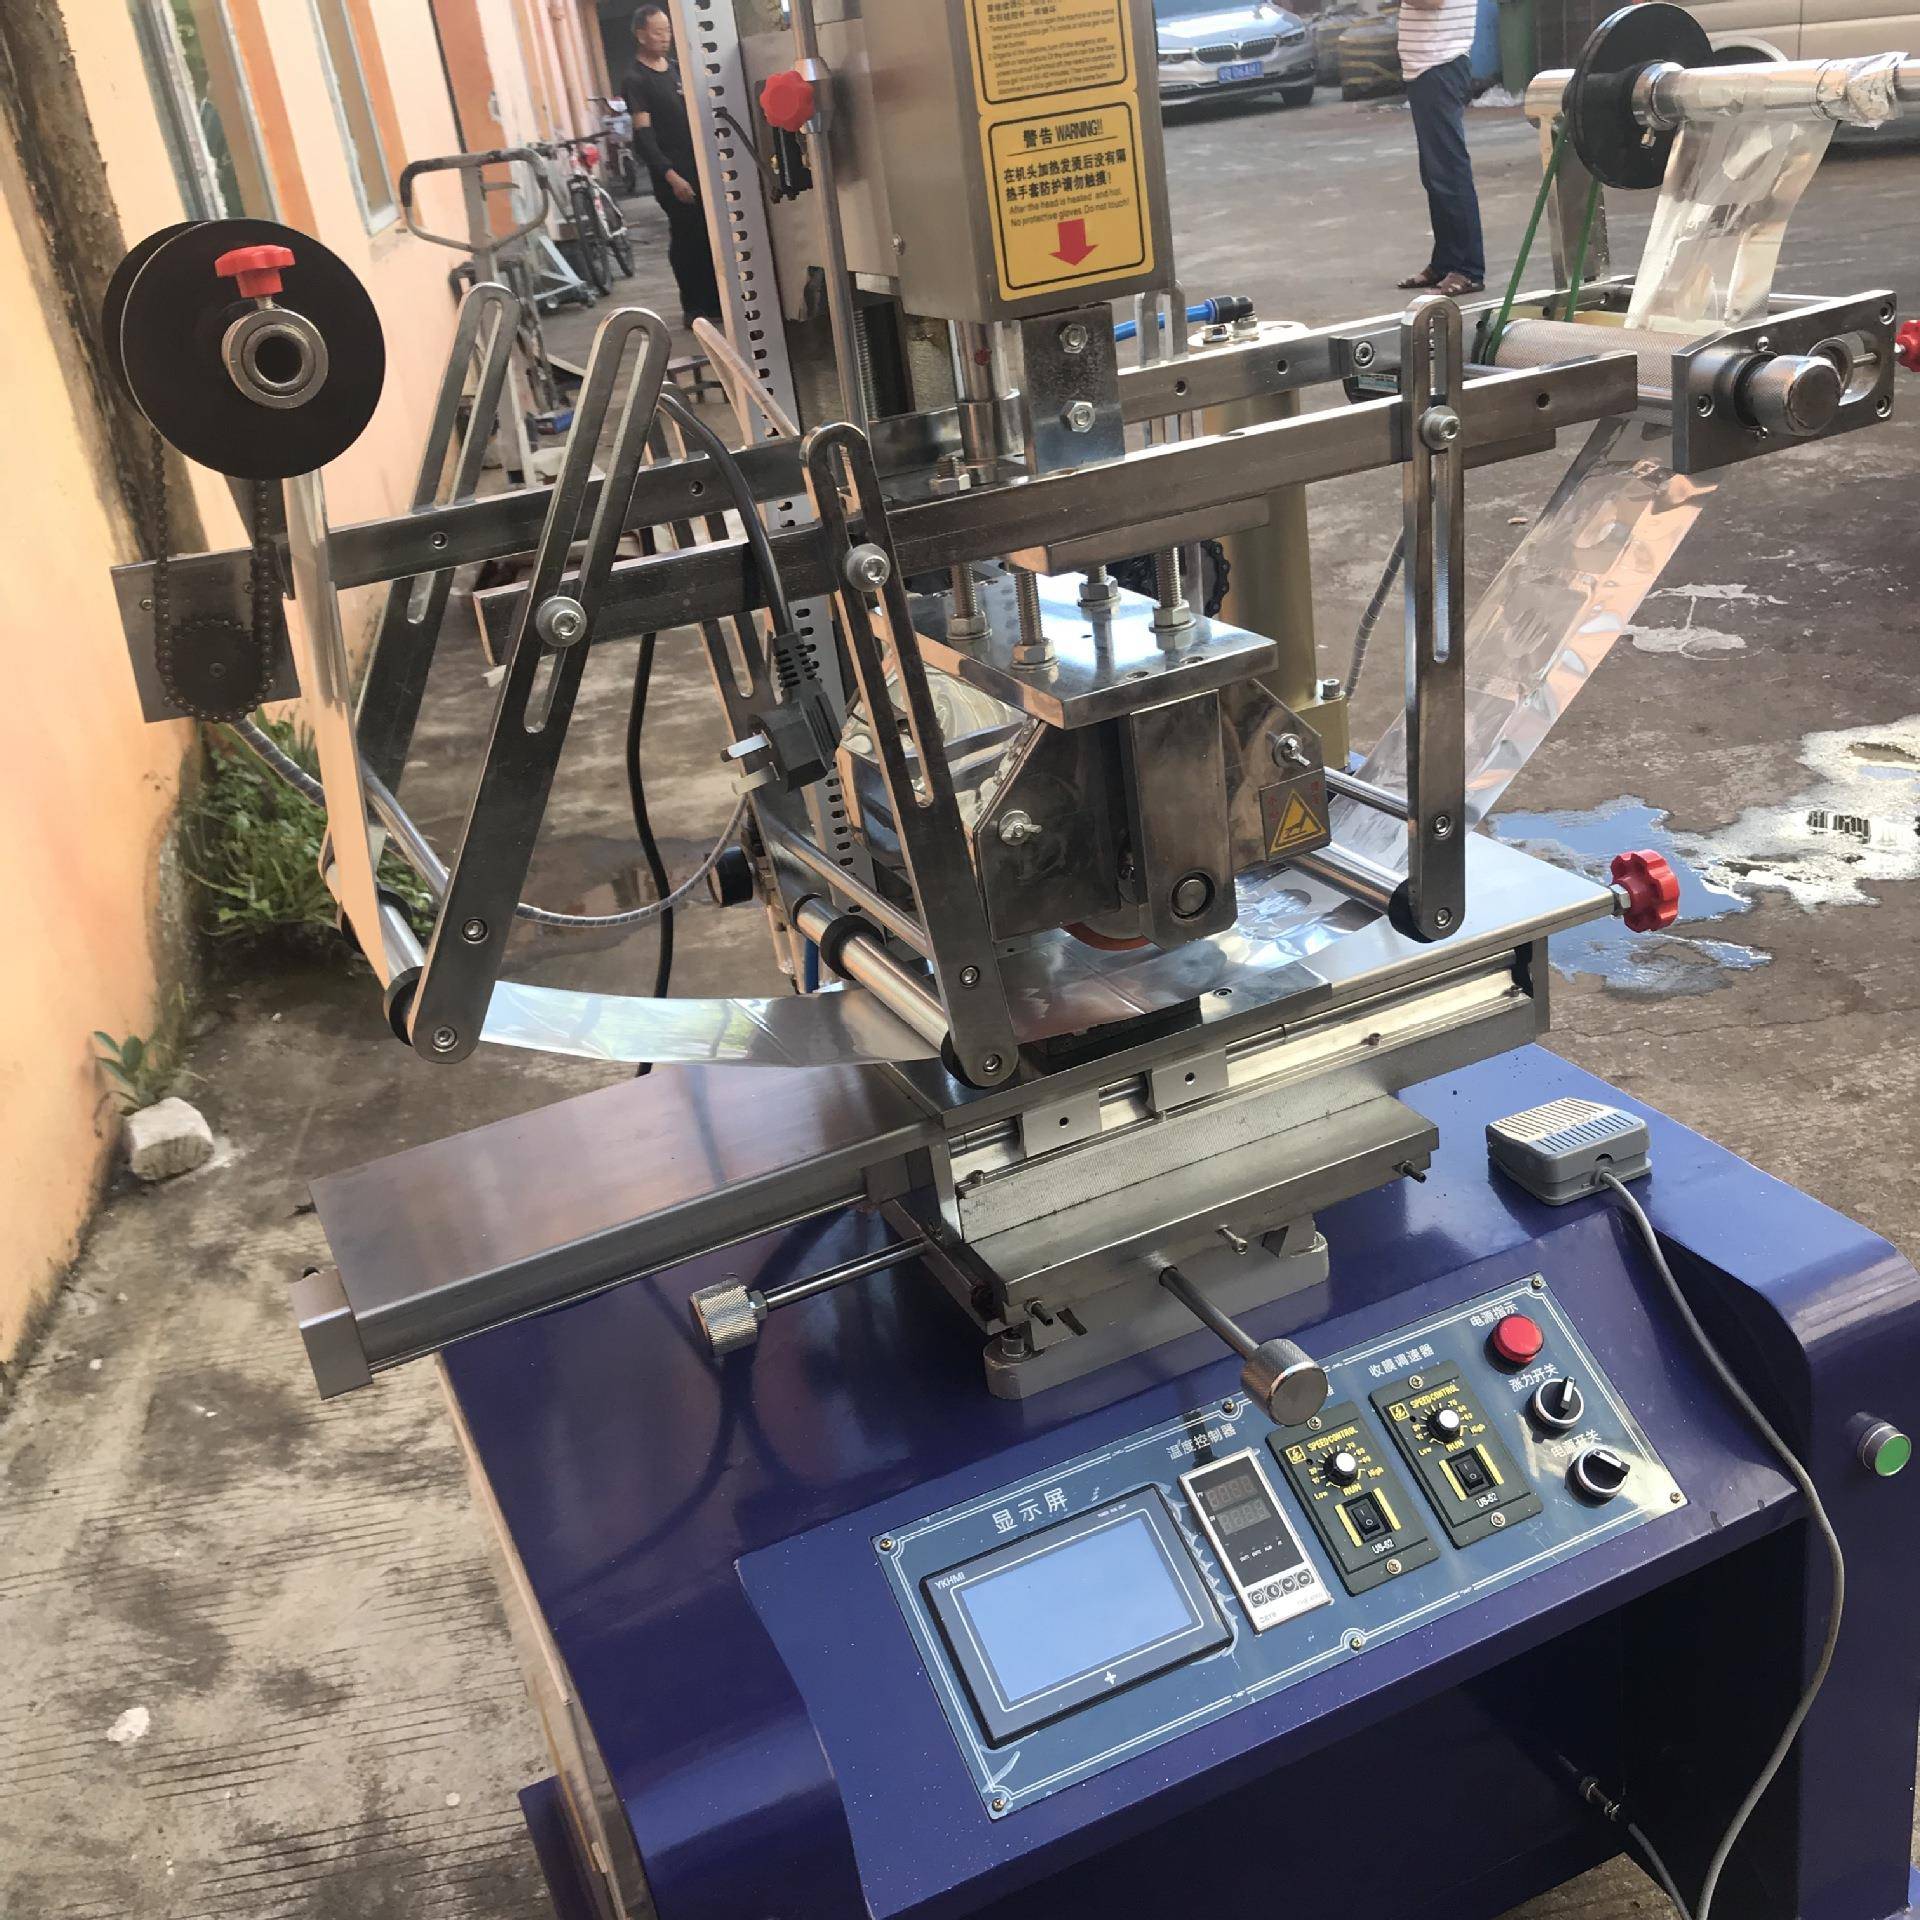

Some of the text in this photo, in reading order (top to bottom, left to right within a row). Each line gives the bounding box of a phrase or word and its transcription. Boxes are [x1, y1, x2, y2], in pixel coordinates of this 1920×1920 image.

[1023, 127, 1053, 148] 警告
[1041, 199, 1059, 208] head
[1368, 1343, 1435, 1378] 收膜调速器
[1508, 1362, 1559, 1393] 张力开关
[1410, 1384, 1460, 1409] SPEED CONTROL
[1166, 1423, 1237, 1460] 温度控制器
[1307, 1426, 1359, 1452] SPEED CONTROL
[1446, 1438, 1465, 1453] RUN
[1342, 1482, 1363, 1497] RUN
[991, 1487, 1068, 1534] 显示屏
